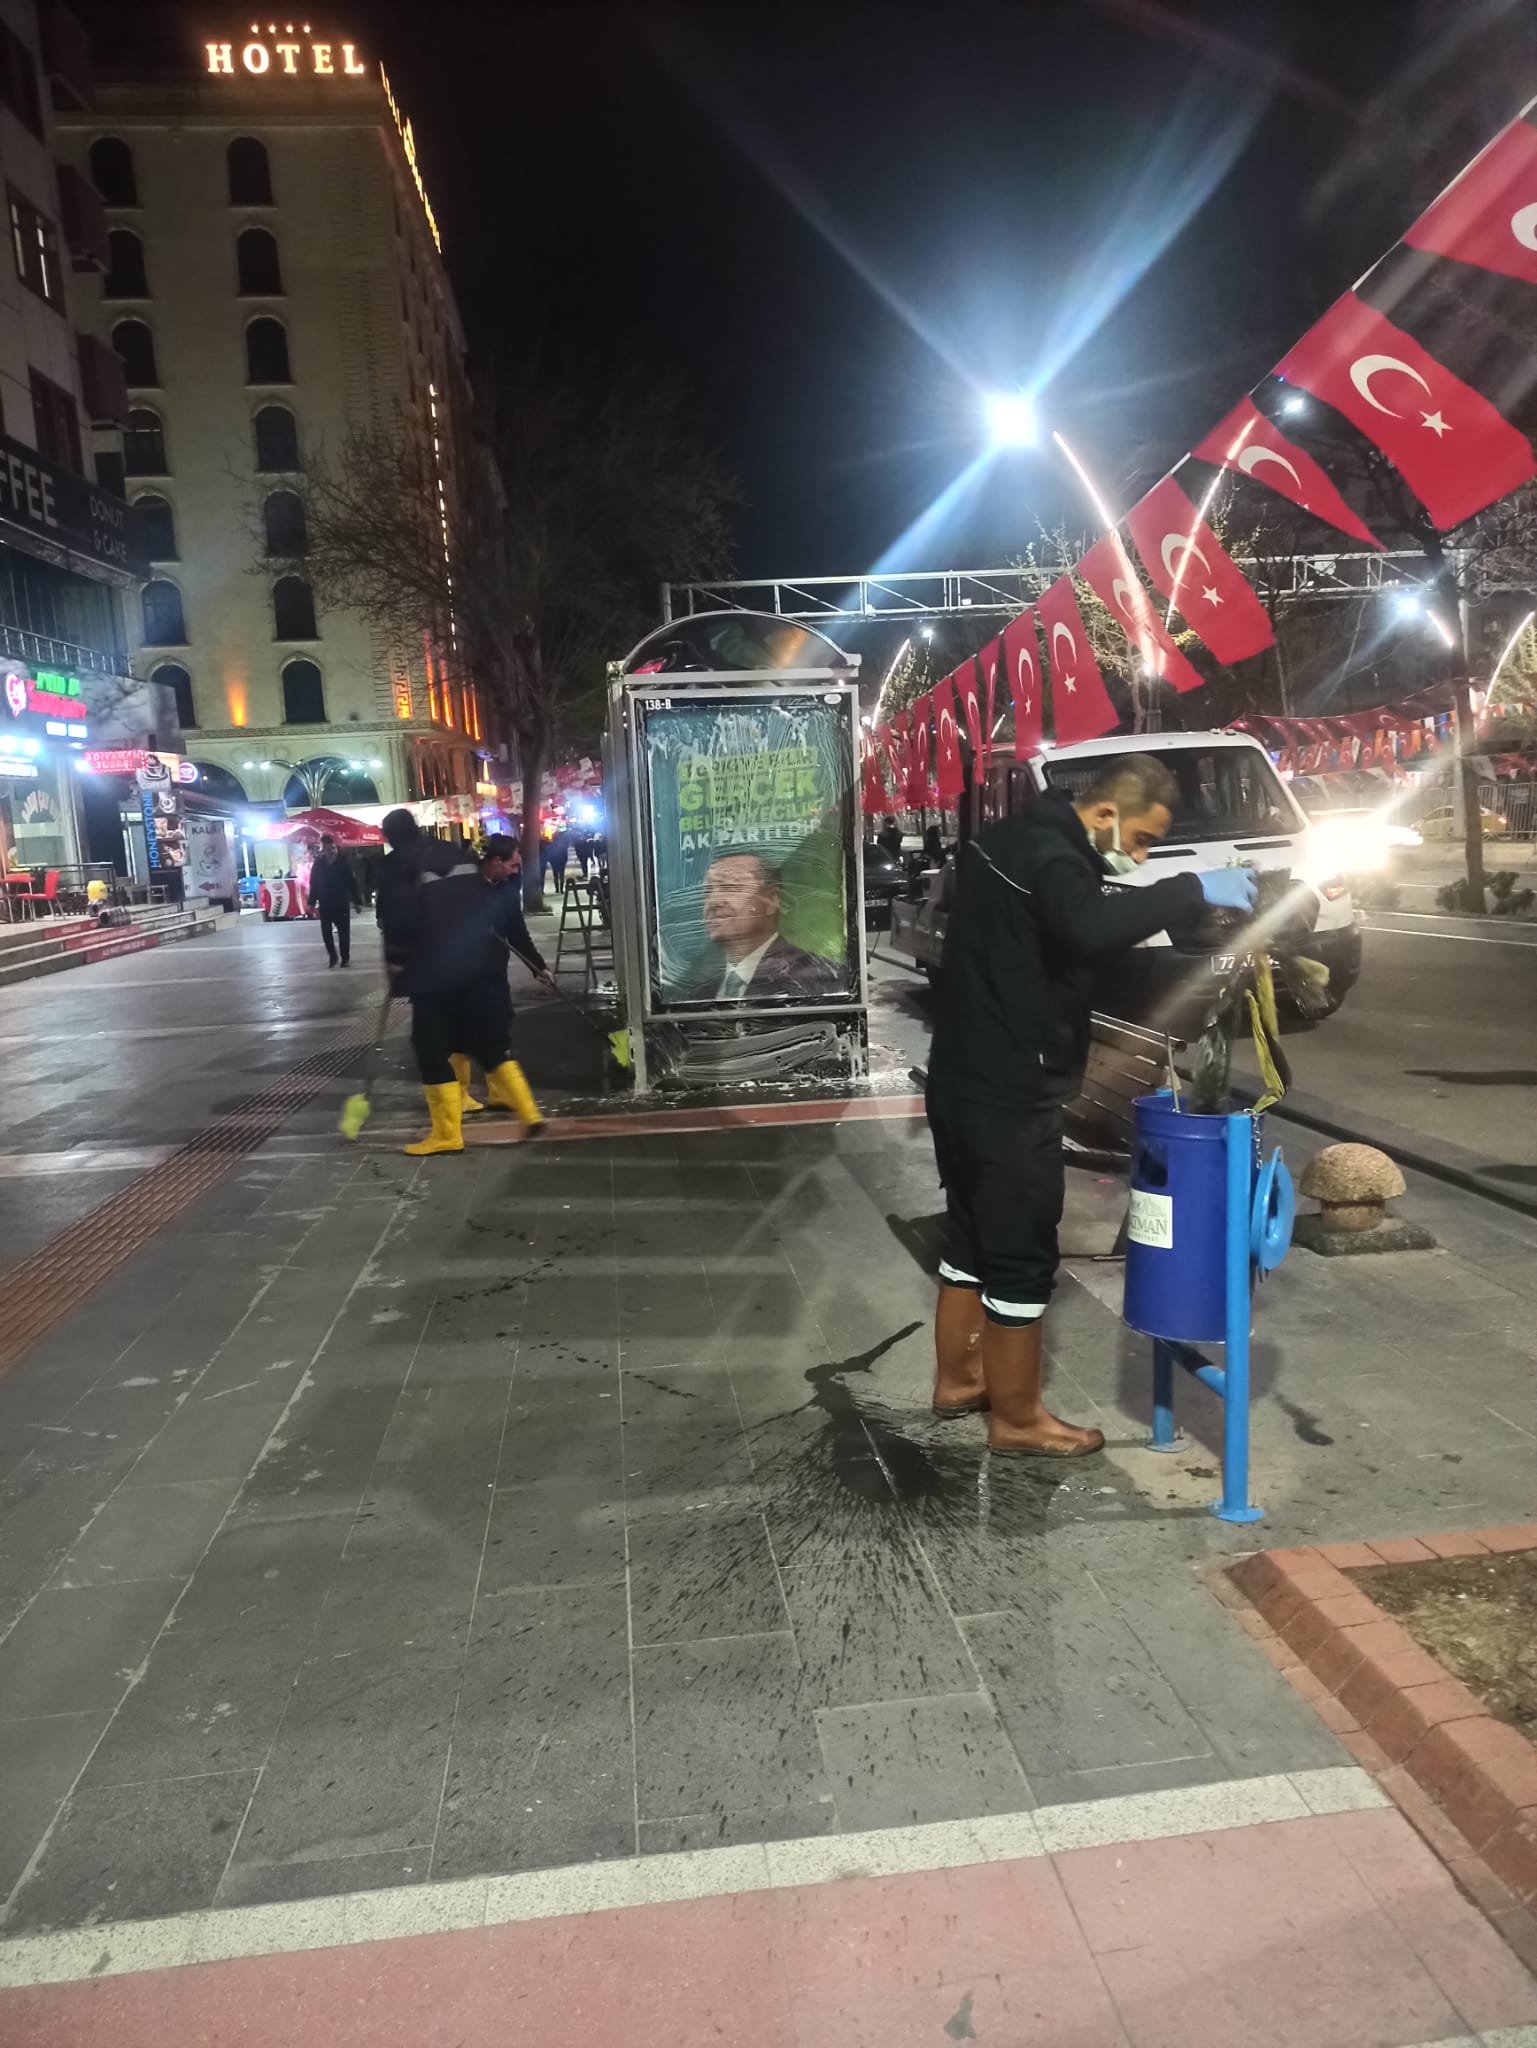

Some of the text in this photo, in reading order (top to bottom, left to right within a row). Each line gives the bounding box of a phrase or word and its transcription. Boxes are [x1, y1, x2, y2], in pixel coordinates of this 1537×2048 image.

[205, 43, 365, 74] HOTEL
[645, 698, 672, 711] 138-B
[681, 832, 712, 850] AK
